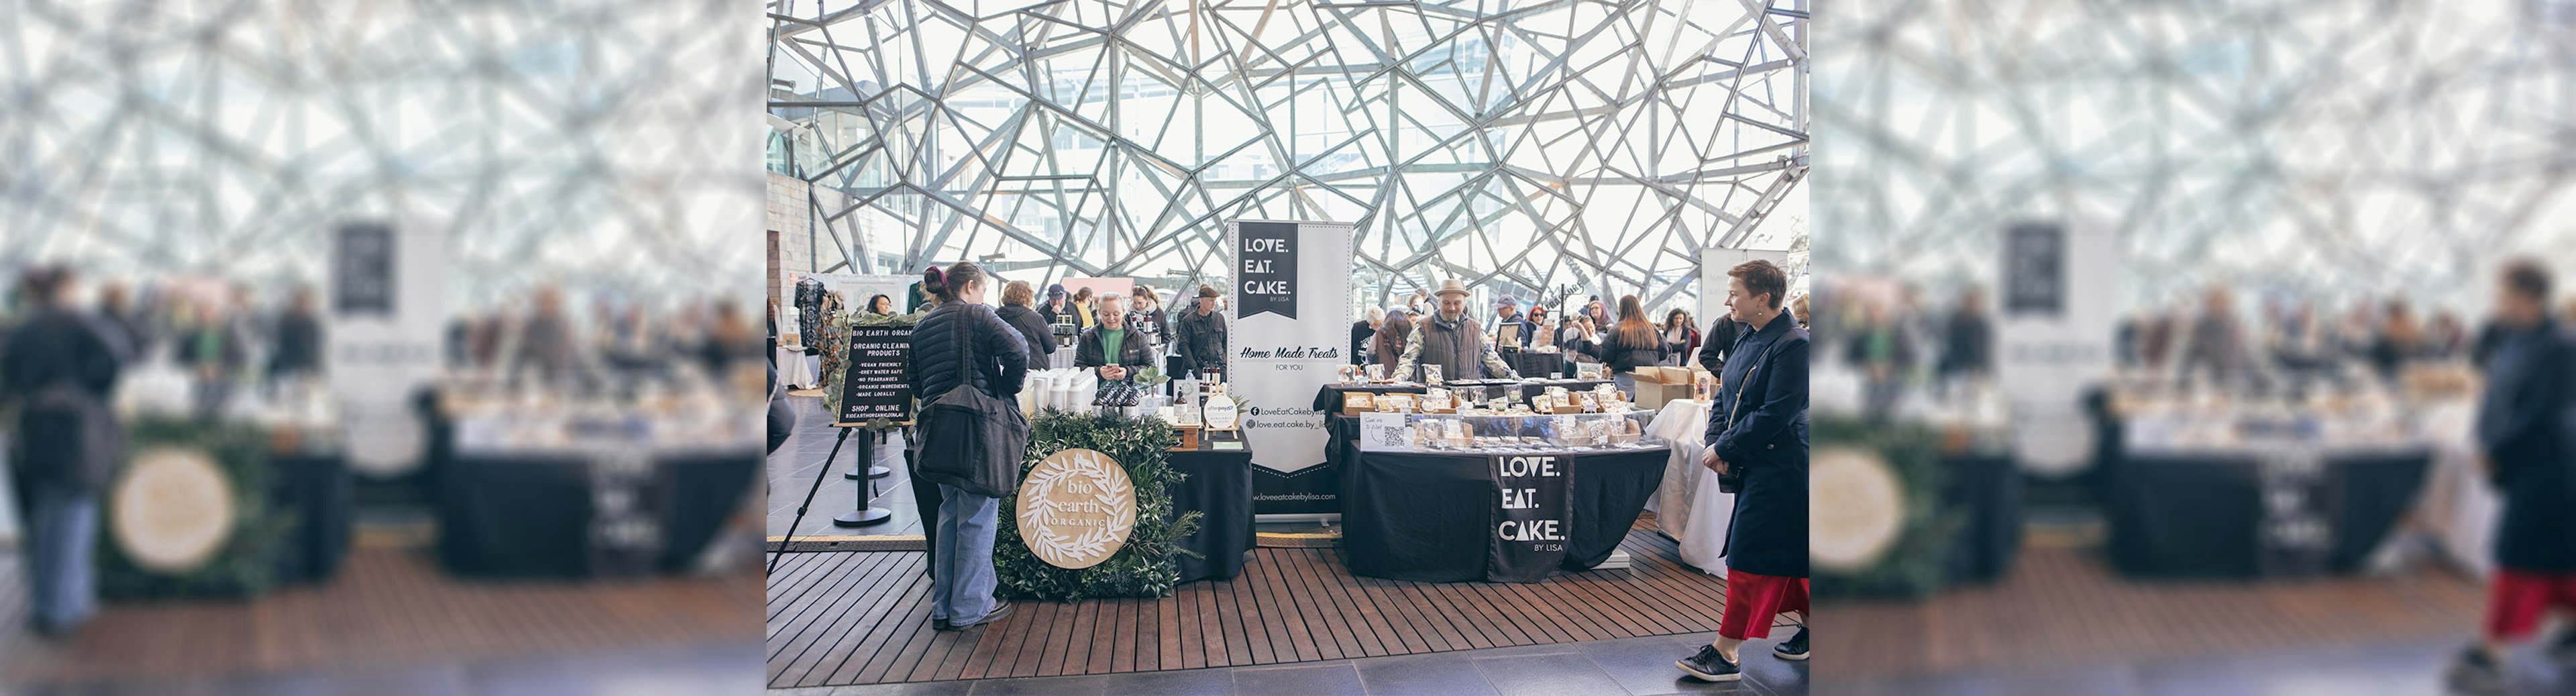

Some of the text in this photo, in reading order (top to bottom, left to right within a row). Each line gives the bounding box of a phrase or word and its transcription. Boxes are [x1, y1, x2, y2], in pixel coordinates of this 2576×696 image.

[1245, 238, 1289, 252] LOVE.
[1245, 260, 1274, 273] EAT.
[1244, 281, 1291, 295] CAKE.
[1240, 346, 1338, 358] Home Made Treats
[1499, 456, 1560, 477] LOVE.
[1068, 479, 1092, 495] bio
[1501, 488, 1540, 509] EAT.
[1058, 499, 1099, 513] earth
[1051, 518, 1106, 527] ORGANIC
[1498, 519, 1566, 541] CAKE.
